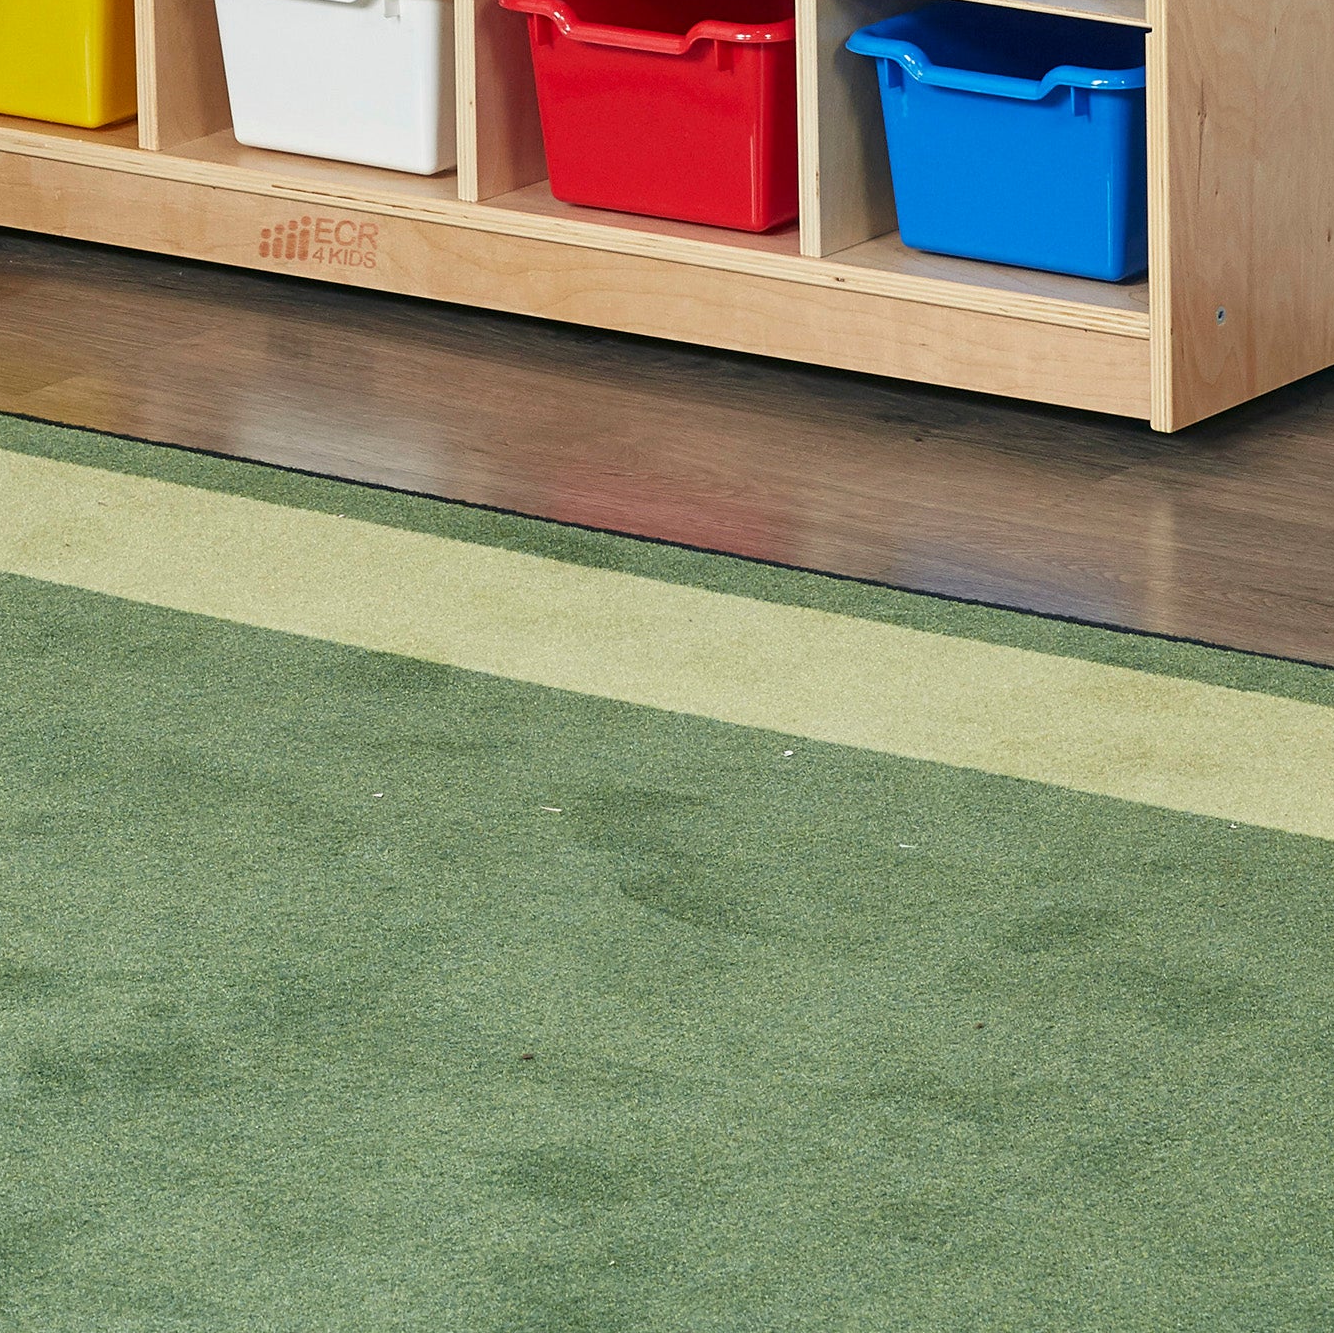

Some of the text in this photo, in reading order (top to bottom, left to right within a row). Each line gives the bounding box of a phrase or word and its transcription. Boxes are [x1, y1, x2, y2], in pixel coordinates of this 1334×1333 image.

[314, 217, 380, 250] ECR
[312, 247, 378, 269] 4 KIDS
